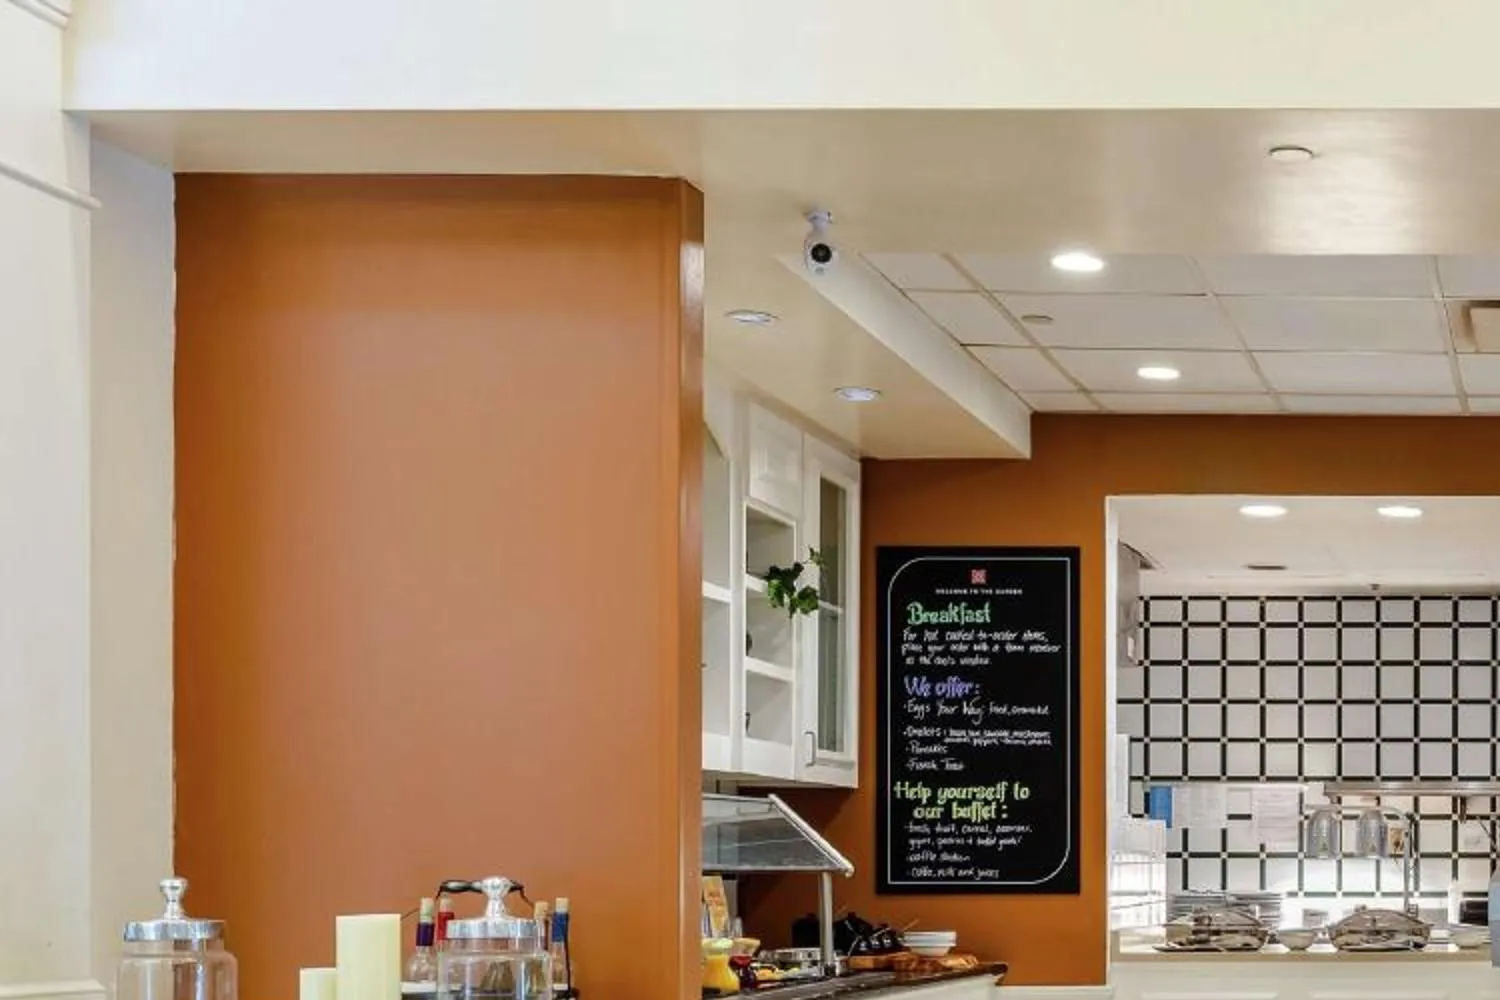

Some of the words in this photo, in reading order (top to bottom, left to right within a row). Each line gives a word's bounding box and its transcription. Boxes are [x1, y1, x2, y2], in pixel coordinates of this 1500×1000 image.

[906, 602, 992, 625] Breakfast
[904, 676, 932, 697] We
[935, 676, 981, 697] offer:
[907, 699, 931, 720] Eggs
[894, 781, 932, 803] Help
[937, 781, 1008, 804] yourself
[1013, 782, 1030, 800] to
[912, 805, 944, 820] our
